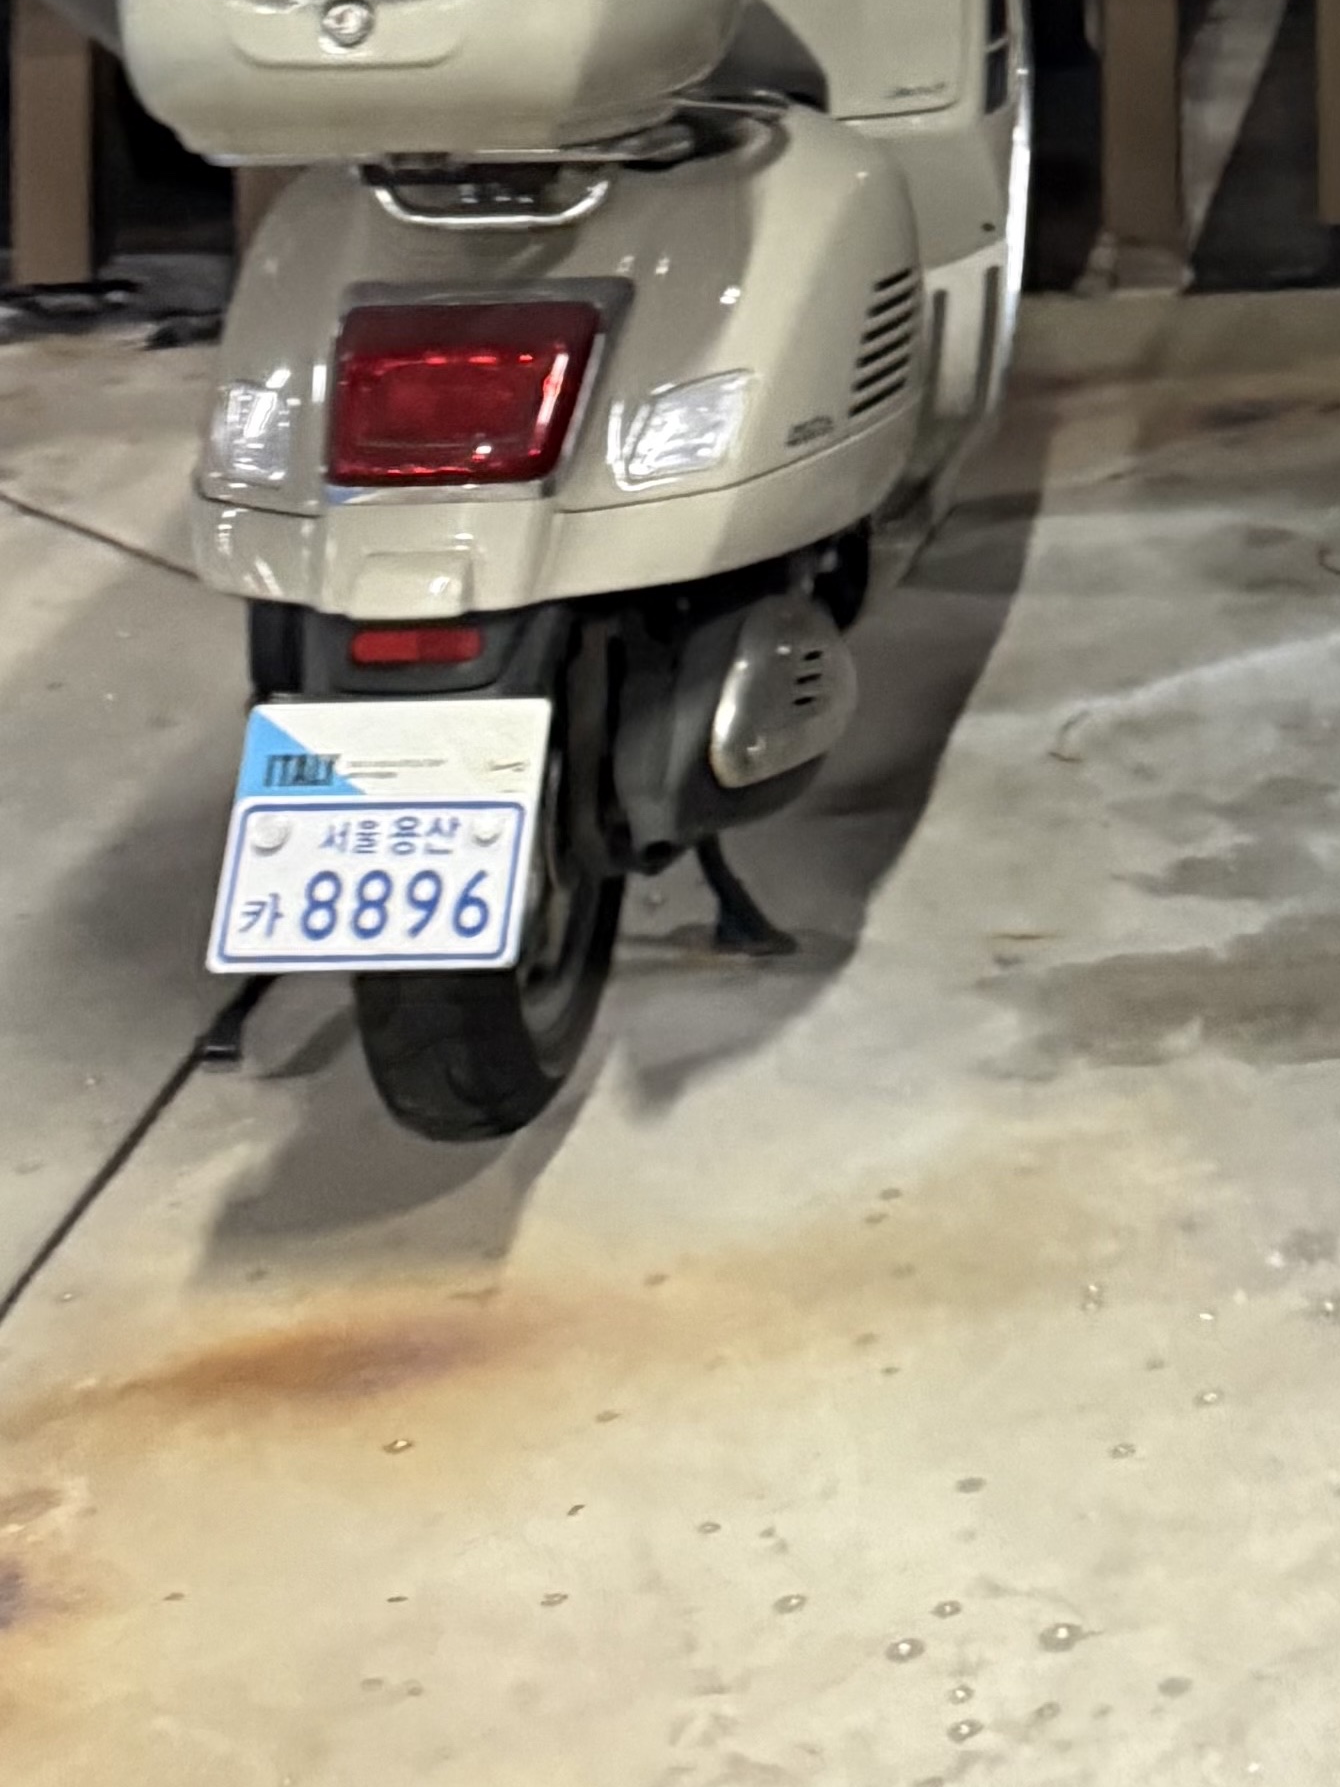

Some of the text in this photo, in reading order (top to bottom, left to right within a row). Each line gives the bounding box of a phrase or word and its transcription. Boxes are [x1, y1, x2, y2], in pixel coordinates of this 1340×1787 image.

[319, 816, 461, 855] 서울용산
[238, 870, 490, 940] 카 8896
